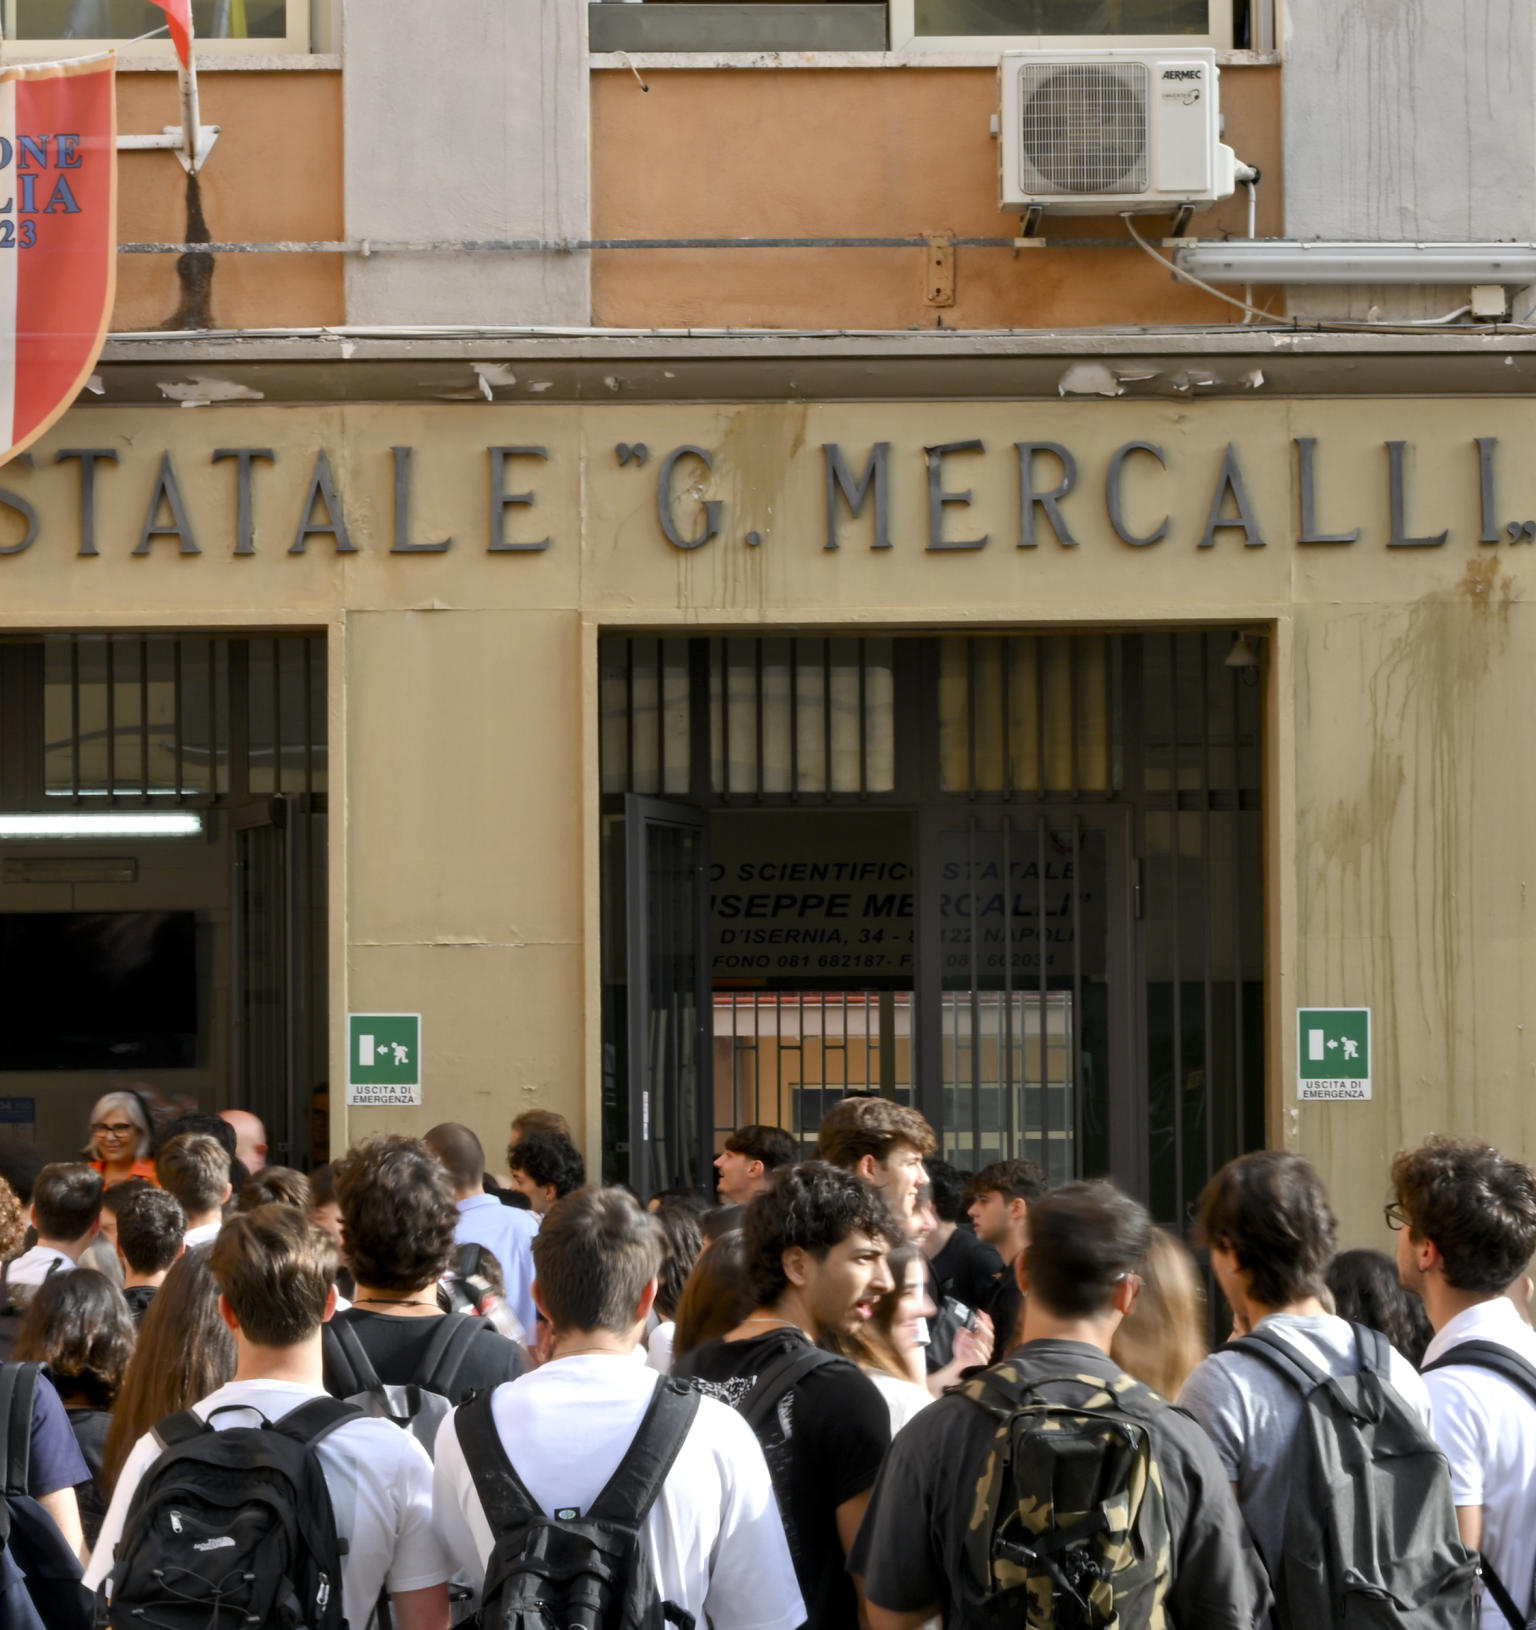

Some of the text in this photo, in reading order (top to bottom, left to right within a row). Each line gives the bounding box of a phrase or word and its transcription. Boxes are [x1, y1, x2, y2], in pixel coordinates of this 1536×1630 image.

[1161, 70, 1202, 82] AERMEC
[737, 862, 913, 882] SCIENTIFIC
[711, 893, 852, 918] SEPPE
[720, 928, 849, 945] D'ISERNIA,
[857, 928, 884, 944] 34
[711, 954, 770, 968] FONO
[777, 954, 809, 968] 081
[946, 953, 979, 968] 08
[356, 1086, 412, 1094] USCITA DI
[1305, 1080, 1362, 1089] USCITA DI
[352, 1095, 415, 1104] EMERGENZA
[1303, 1089, 1365, 1098] EMERGENZA
